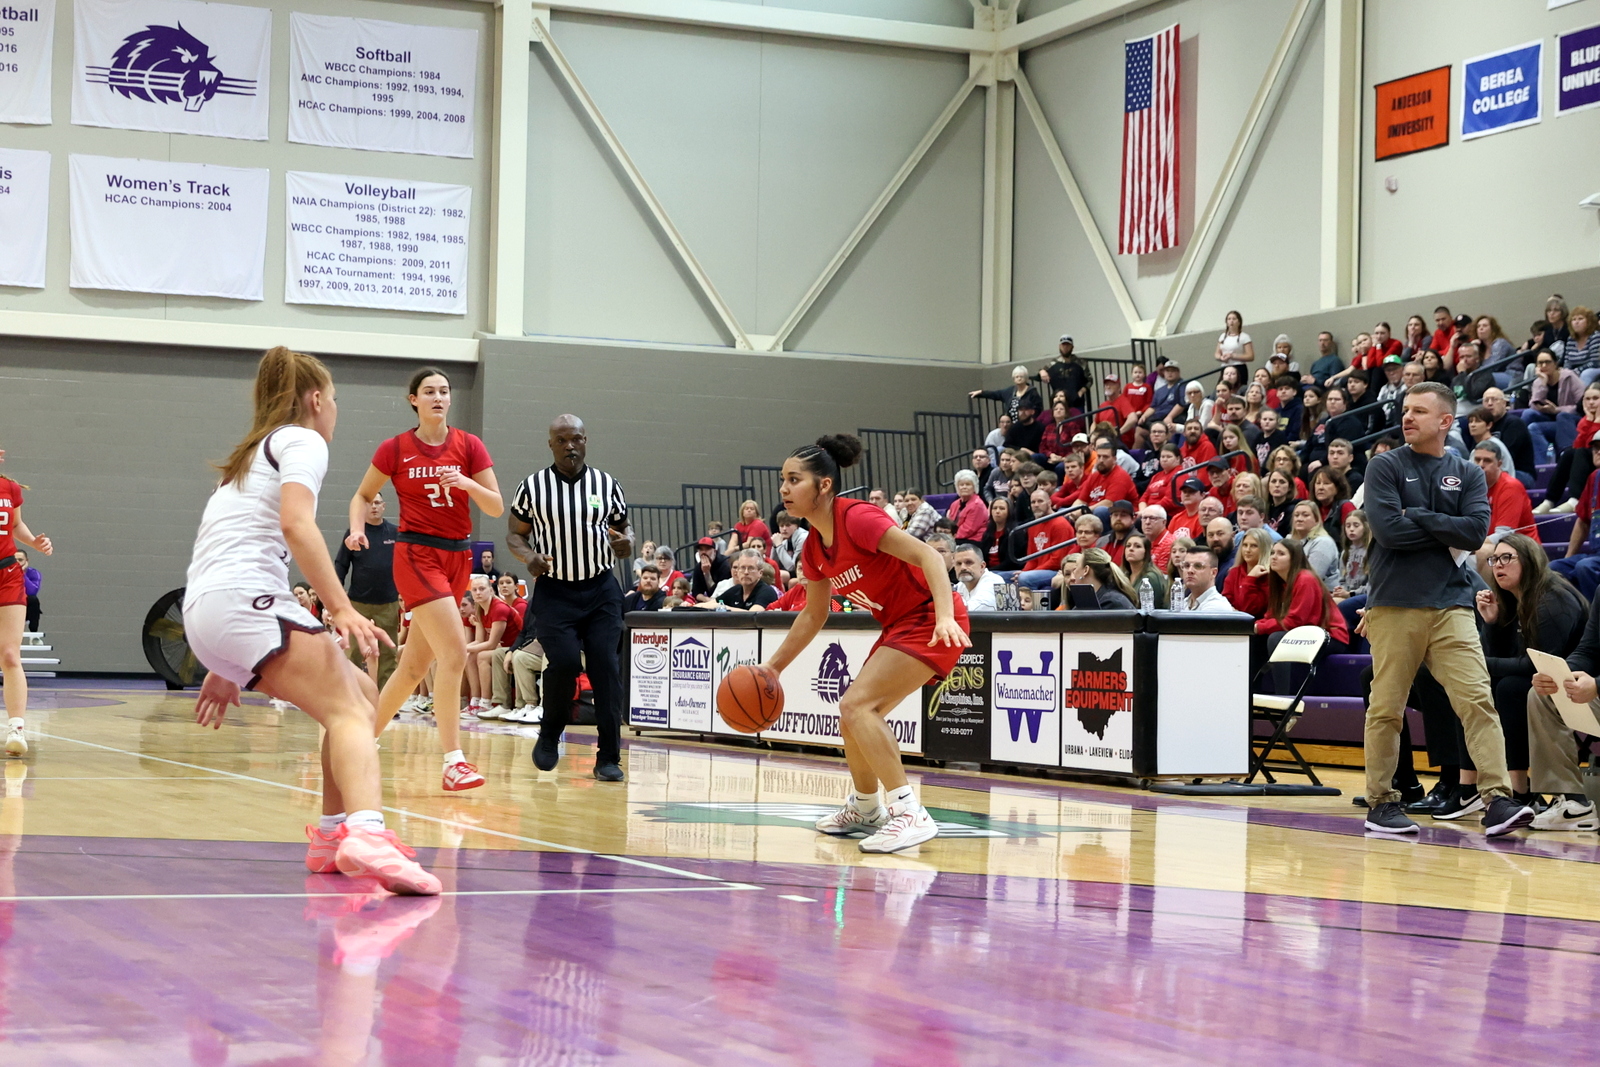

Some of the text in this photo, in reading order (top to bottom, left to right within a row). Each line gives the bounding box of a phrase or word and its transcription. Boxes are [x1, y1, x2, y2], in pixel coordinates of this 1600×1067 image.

[0, 6, 38, 21] tball
[0, 26, 14, 36] 95
[355, 46, 411, 63] Softball
[324, 61, 441, 80] WBCC Champions: 1984
[1480, 66, 1524, 92] BEREA
[301, 73, 464, 98] AMC Champions: 1992, 1993, 1994,
[372, 93, 394, 103] 1995
[1391, 89, 1432, 111] ANDERSON
[1472, 85, 1530, 115] COLLEGE
[298, 99, 466, 123] HCAC Champions: 1999, 2004, 2008
[1387, 115, 1434, 139] UNIVERSITY
[187, 180, 231, 197] Track
[345, 182, 416, 200] Volleyball
[104, 193, 232, 212] HCAC Champions: 2004
[292, 196, 466, 219] NAIA Champions (District 22): 1982,
[355, 213, 406, 225] 1985, 1988
[291, 222, 466, 246] WBCC Champions: 1982, 1984, 1985,
[340, 239, 419, 253] 1987, 1988, 1990
[306, 250, 451, 269] HCAC Champions: 2009, 2011
[304, 264, 453, 285] NCAA Tournament: 1994, 1996,
[298, 279, 458, 299] 1997, 2009, 2013, 2014, 2015, 2016
[829, 564, 864, 590] LLEVUE
[632, 631, 669, 647] Interdyne
[1281, 638, 1318, 646] BLUFFTON
[672, 648, 711, 669] STOLLY
[957, 654, 984, 664] ERPIECE
[672, 670, 696, 680] INSURANCE
[695, 671, 710, 681] GROUP
[1070, 668, 1128, 691] FARMERS
[997, 682, 1054, 701] Wannemacher
[1065, 688, 1134, 712] EQUIPMENT
[675, 695, 707, 709] Auto-Owners
[1064, 744, 1084, 756] URBANA
[1089, 746, 1114, 759] LAKEVIEW
